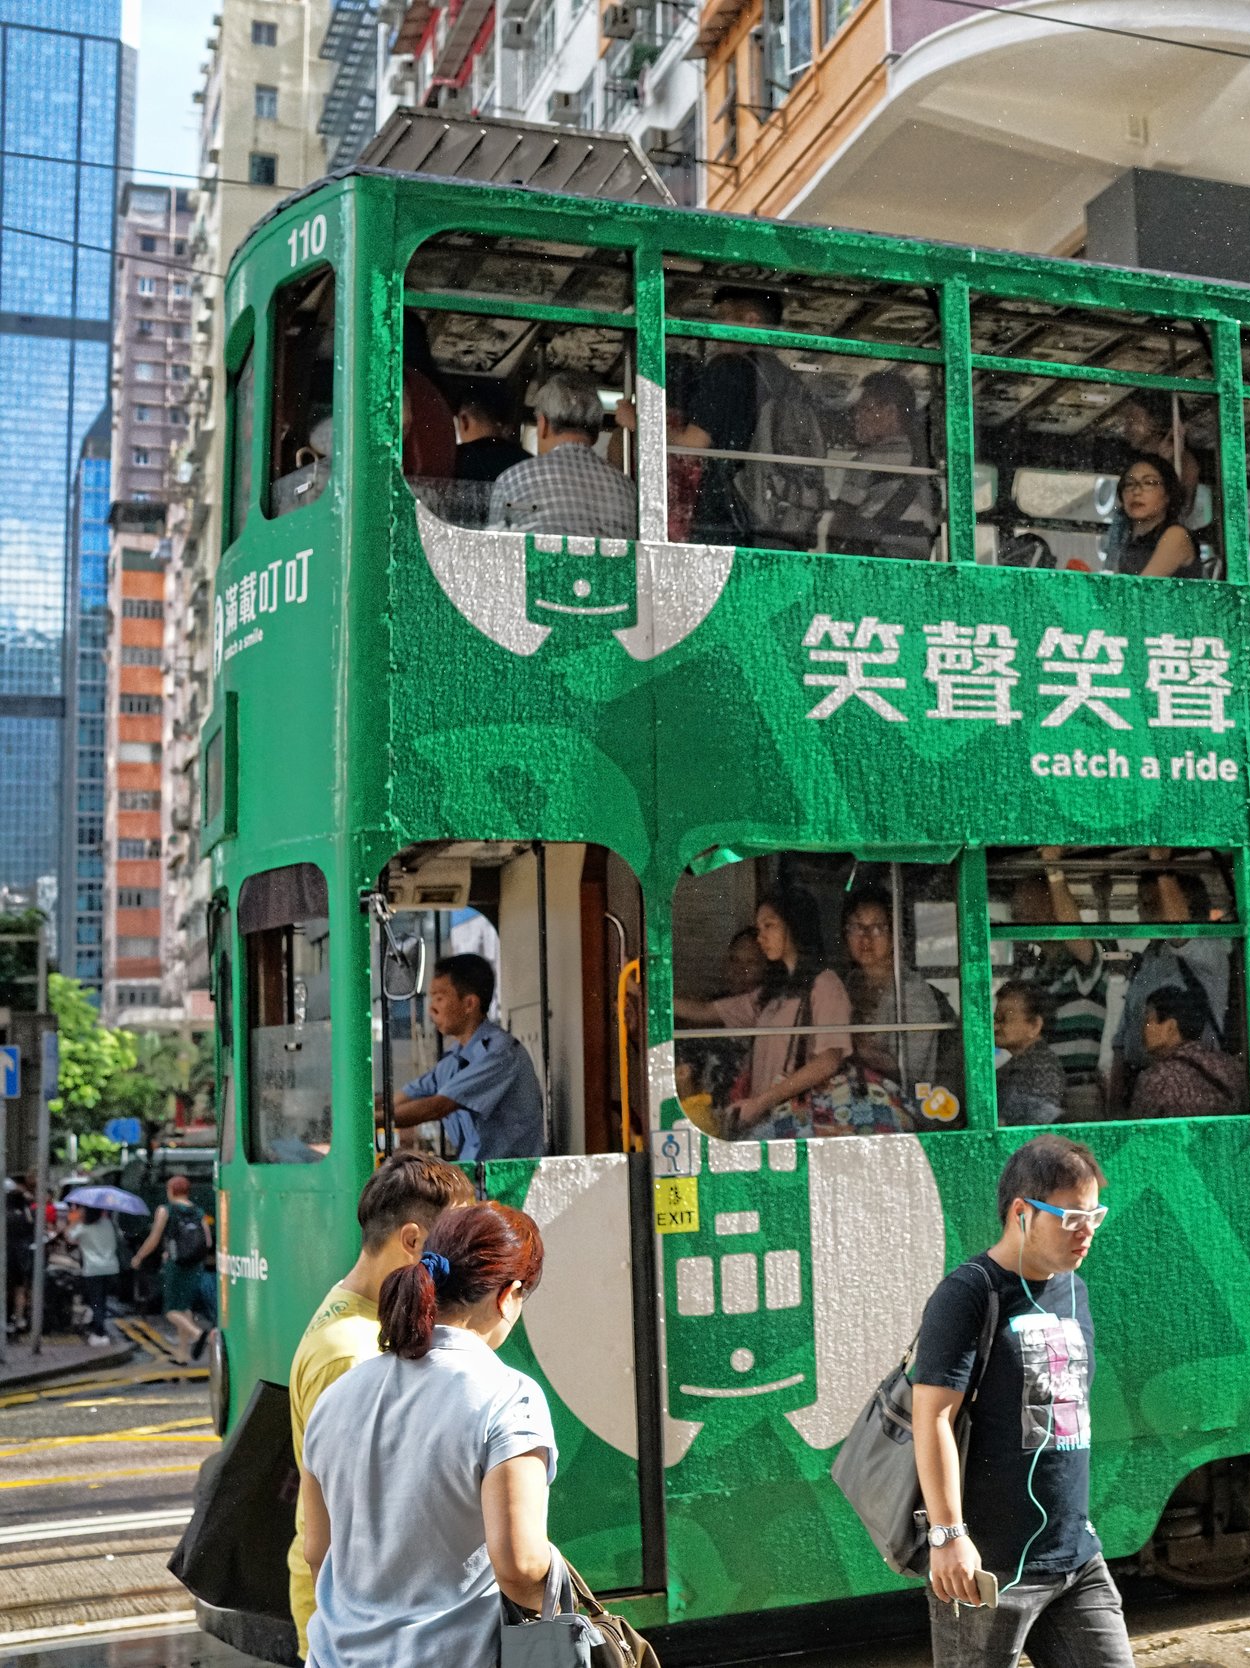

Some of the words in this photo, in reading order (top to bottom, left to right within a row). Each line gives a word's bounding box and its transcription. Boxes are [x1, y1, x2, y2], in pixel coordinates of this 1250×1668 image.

[287, 213, 328, 268] 110
[801, 613, 1236, 734] 笑聲笑聲
[1030, 748, 1130, 779] catch
[1140, 756, 1161, 780] a
[1170, 751, 1239, 781] ride
[656, 1210, 695, 1226] EXIT
